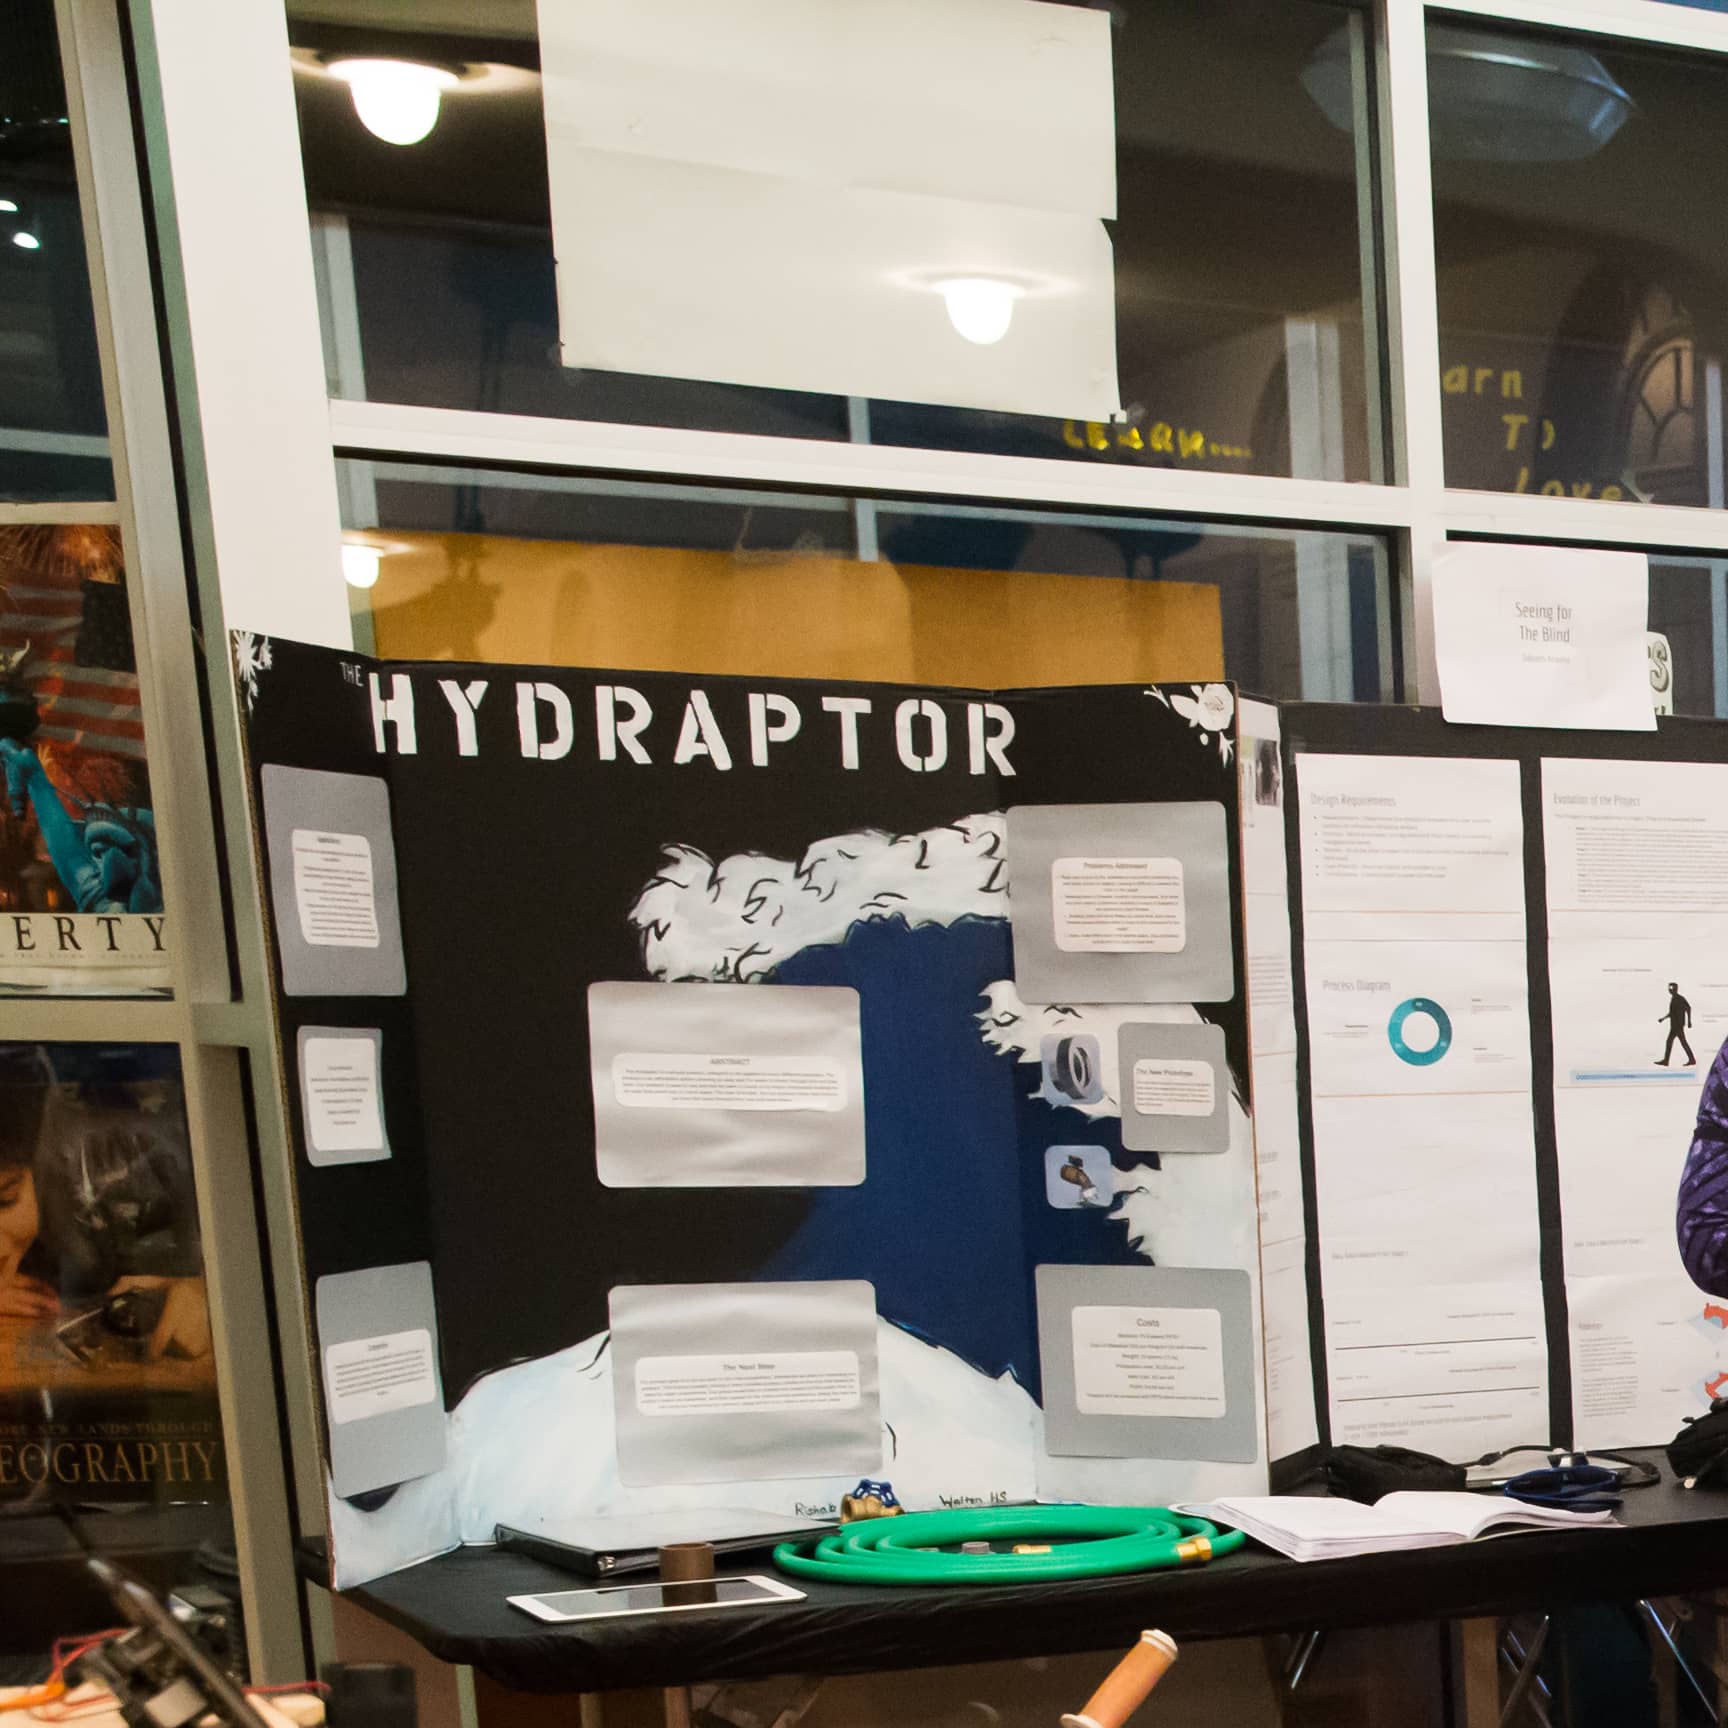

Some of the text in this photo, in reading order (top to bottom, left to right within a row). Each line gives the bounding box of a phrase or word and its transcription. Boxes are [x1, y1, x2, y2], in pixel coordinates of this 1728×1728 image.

[1515, 602, 1573, 622] Seeing for
[1520, 625, 1570, 643] The Blind
[341, 662, 364, 687] THE
[369, 672, 1018, 777] HYDRAPTOR
[1136, 1318, 1160, 1327] Costs
